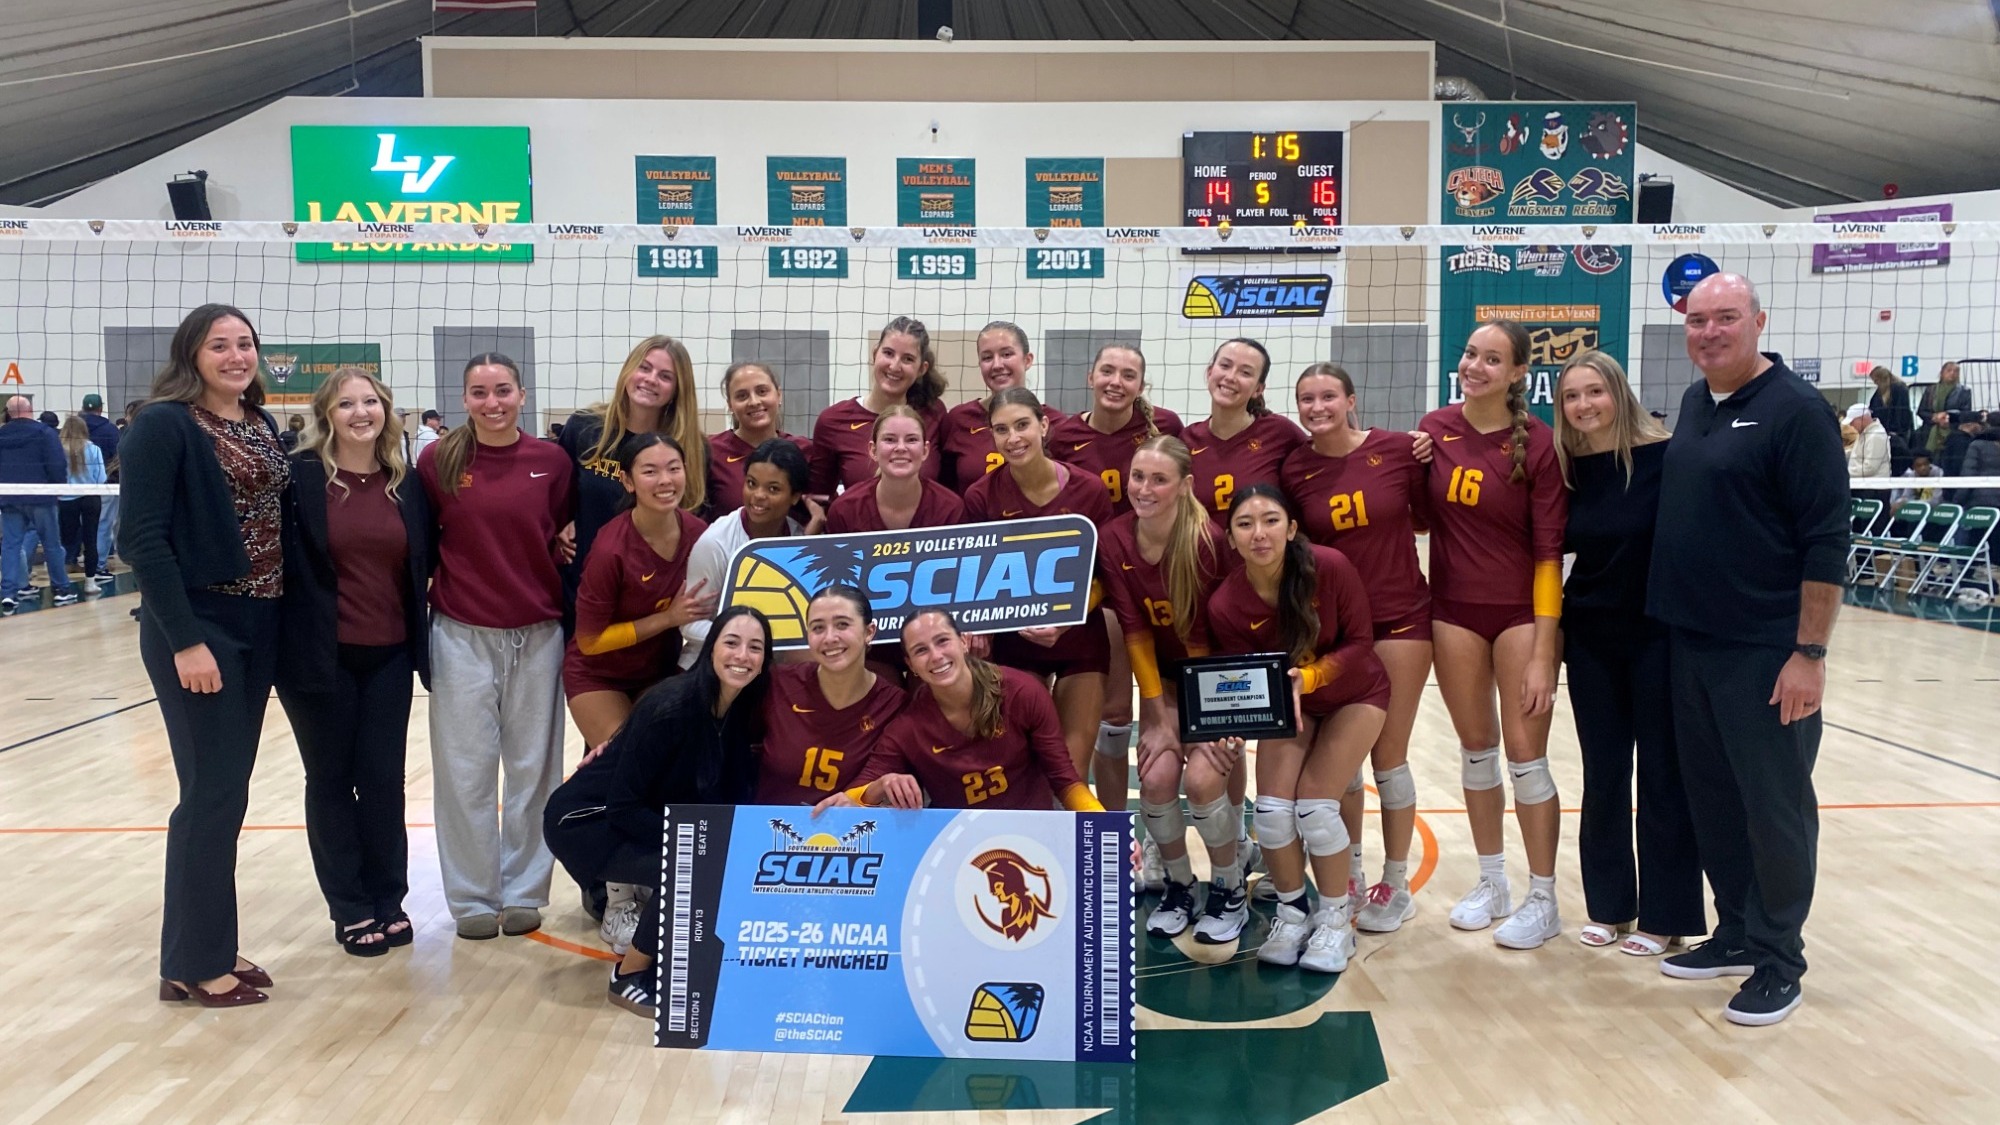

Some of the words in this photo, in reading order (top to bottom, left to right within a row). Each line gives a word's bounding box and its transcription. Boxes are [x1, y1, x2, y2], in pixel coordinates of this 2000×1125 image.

[1254, 134, 1299, 160] 1:15
[371, 133, 456, 193] LV
[919, 164, 954, 174] MEN'S
[1194, 165, 1227, 178] HOME
[1298, 165, 1334, 177] GUEST
[645, 171, 711, 180] VOLLEYBALL
[777, 171, 841, 181] VOLLEYBALL
[903, 175, 970, 186] VOLLEYBALL
[1035, 173, 1099, 182] VOLLEYBALL
[1249, 172, 1277, 181] PERIOD
[1449, 168, 1504, 189] CALTECH
[1208, 182, 1230, 205] 14
[1255, 182, 1270, 204] 5
[1313, 180, 1335, 205] 16
[658, 202, 693, 210] LEOPARDS
[791, 203, 826, 211] LEOPARDS
[1188, 208, 1212, 217] FOULS
[1236, 208, 1264, 217] PLAYER
[1270, 208, 1289, 217] FOUL
[1313, 208, 1337, 217] FOULS
[1508, 204, 1567, 216] KINGSMEN
[1572, 204, 1617, 216] REGALS
[662, 216, 695, 226] AIAW
[792, 217, 824, 227] NCAA
[1050, 218, 1082, 228] NCAA
[649, 248, 704, 269] 1981
[781, 249, 838, 269] 1982
[909, 255, 966, 275] 1999
[1037, 250, 1091, 270] 2001
[1446, 251, 1511, 272] TIGERS
[1517, 250, 1564, 264] WHITTIER
[1237, 286, 1327, 307] SCIAC
[1235, 308, 1276, 316] TOURNAMENT
[1480, 307, 1537, 319] UNIVERSITY
[1551, 307, 1564, 319] LA
[1566, 307, 1596, 319] VERNE
[2, 362, 24, 384] A
[301, 364, 311, 374] LA
[1902, 355, 1919, 377] B
[1101, 469, 1122, 503] 9
[1214, 473, 1234, 511] 2
[1446, 465, 1484, 507] 16
[1329, 490, 1369, 531] 21
[872, 542, 911, 557] 2025
[915, 534, 998, 553] VOLLEYBALL
[867, 545, 1080, 611] SCIAC
[961, 602, 1049, 624] CHAMPIONS
[1144, 597, 1176, 626] 13
[1216, 680, 1251, 692] SCIAC
[1204, 695, 1236, 703] TOURNAMENT
[1200, 714, 1233, 726] WOMEN'S
[1234, 713, 1274, 724] VOLLEYBALL
[799, 747, 844, 792] 15
[962, 766, 1008, 805] 23
[699, 819, 708, 831] 22
[698, 832, 706, 856] SEAT
[1084, 820, 1094, 876] QUALIFIER
[758, 854, 880, 885] SCIAC
[753, 886, 805, 894] INTERCOLLEGIATE
[695, 909, 704, 919] 13
[1084, 877, 1094, 941] AUTOMATIC
[694, 920, 703, 942] ROW
[738, 920, 824, 944] 2025-26
[830, 923, 888, 946] NCAA
[738, 946, 800, 968] TICKET
[803, 948, 889, 971] PUNCHED
[1084, 943, 1094, 1019] TOURNAMENT
[692, 991, 701, 999] 3
[690, 1000, 700, 1039] SECTION
[775, 1012, 844, 1025] #SCIACtion
[774, 1028, 843, 1042] @theSCIAC
[1084, 1021, 1094, 1052] NCAA
